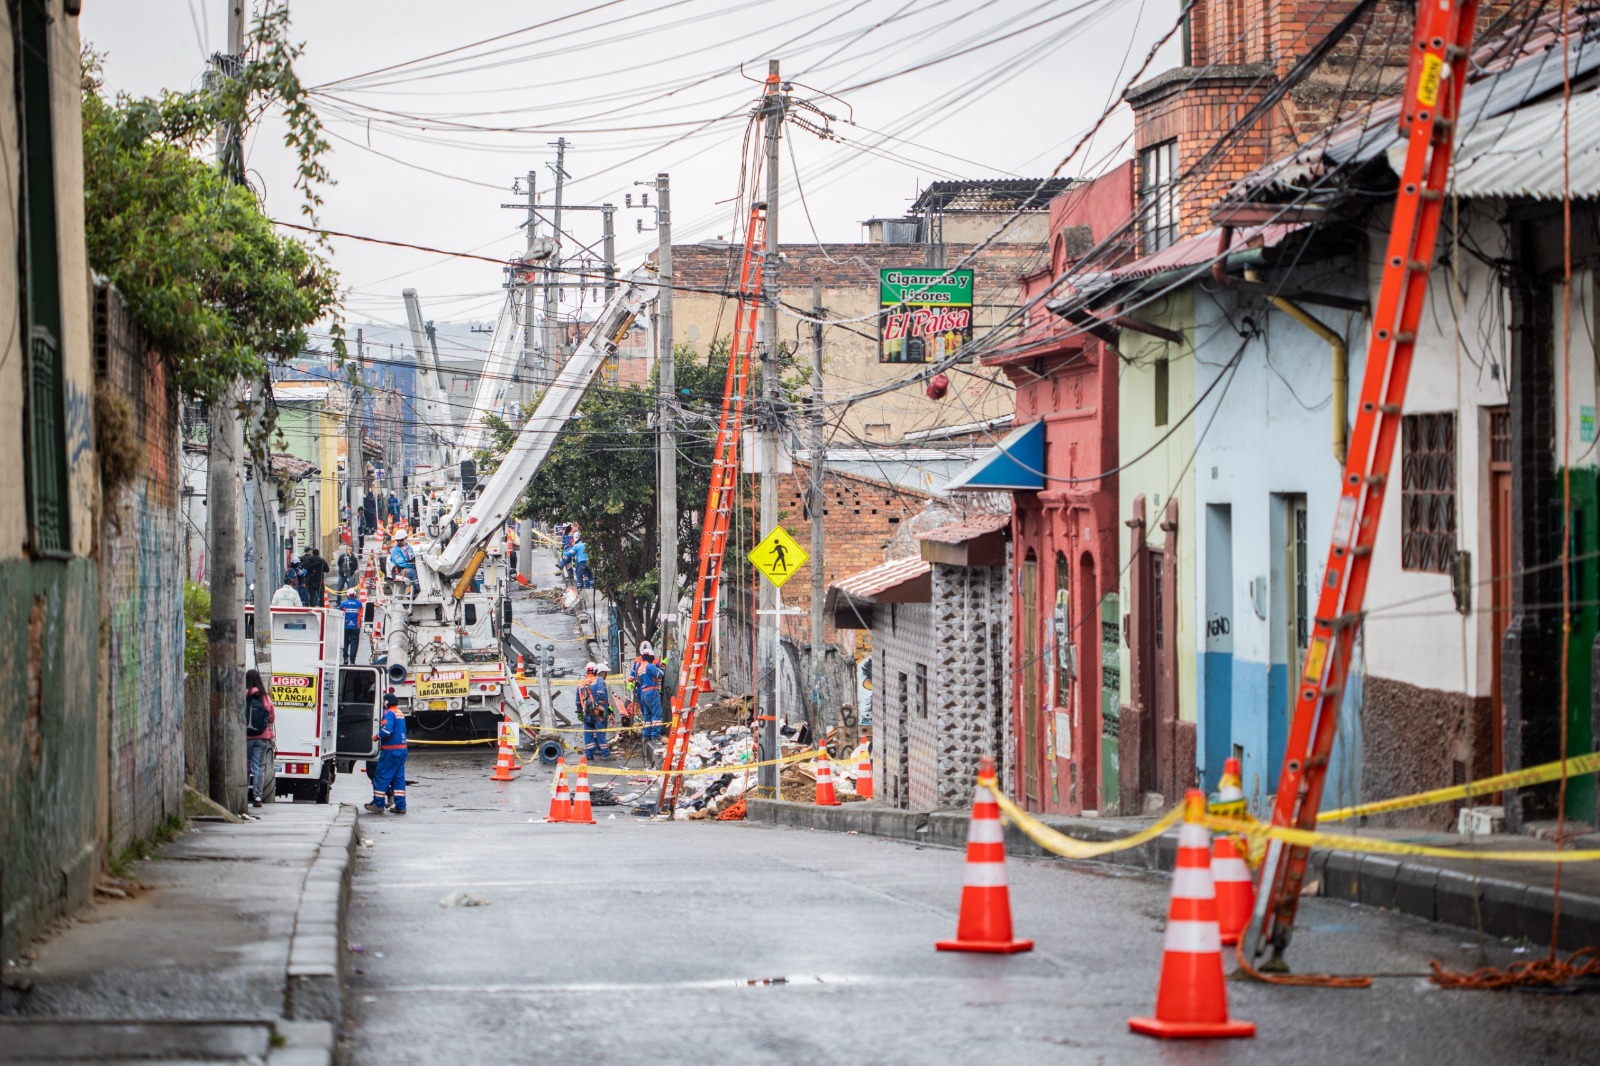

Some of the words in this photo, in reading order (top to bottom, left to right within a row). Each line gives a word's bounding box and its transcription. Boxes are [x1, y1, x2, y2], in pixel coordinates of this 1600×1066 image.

[959, 276, 969, 287] y
[901, 290, 950, 301] Licores
[884, 313, 910, 341] El
[911, 308, 970, 337] Paisa
[295, 488, 307, 548] SASTRE
[272, 677, 305, 686] LIGRO
[285, 694, 313, 702] ANCHA
